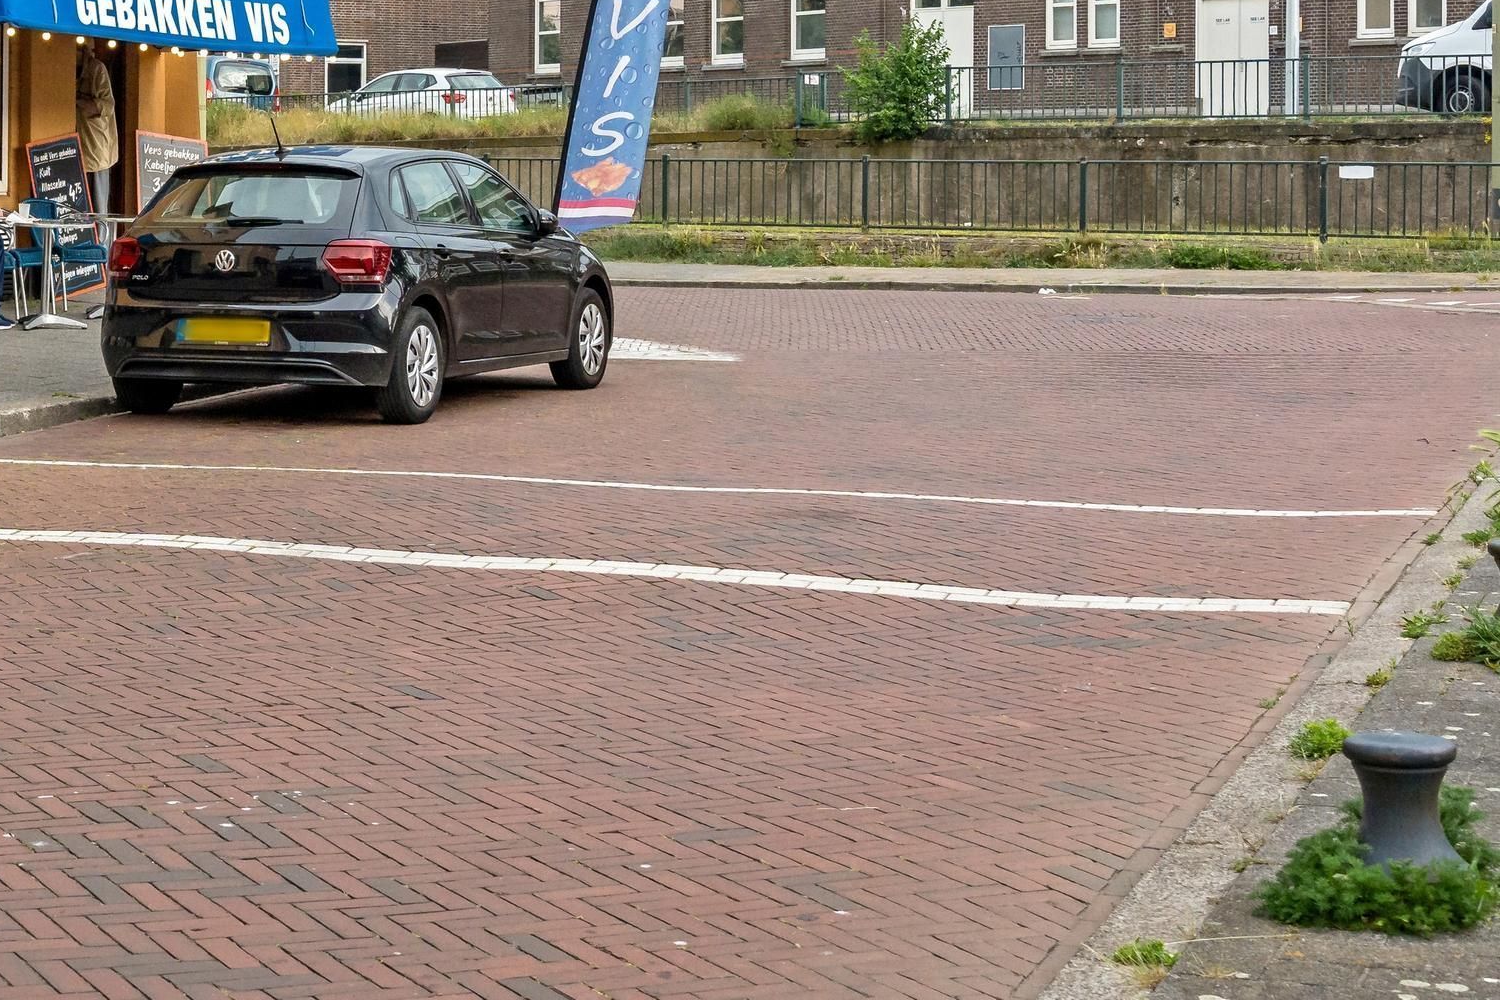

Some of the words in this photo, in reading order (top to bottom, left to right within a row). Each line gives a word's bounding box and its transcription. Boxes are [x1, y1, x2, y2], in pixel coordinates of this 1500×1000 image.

[243, 1, 291, 46] VIS
[143, 143, 162, 155] Vers
[163, 147, 200, 160] gebakken
[41, 178, 67, 193] Mosselen
